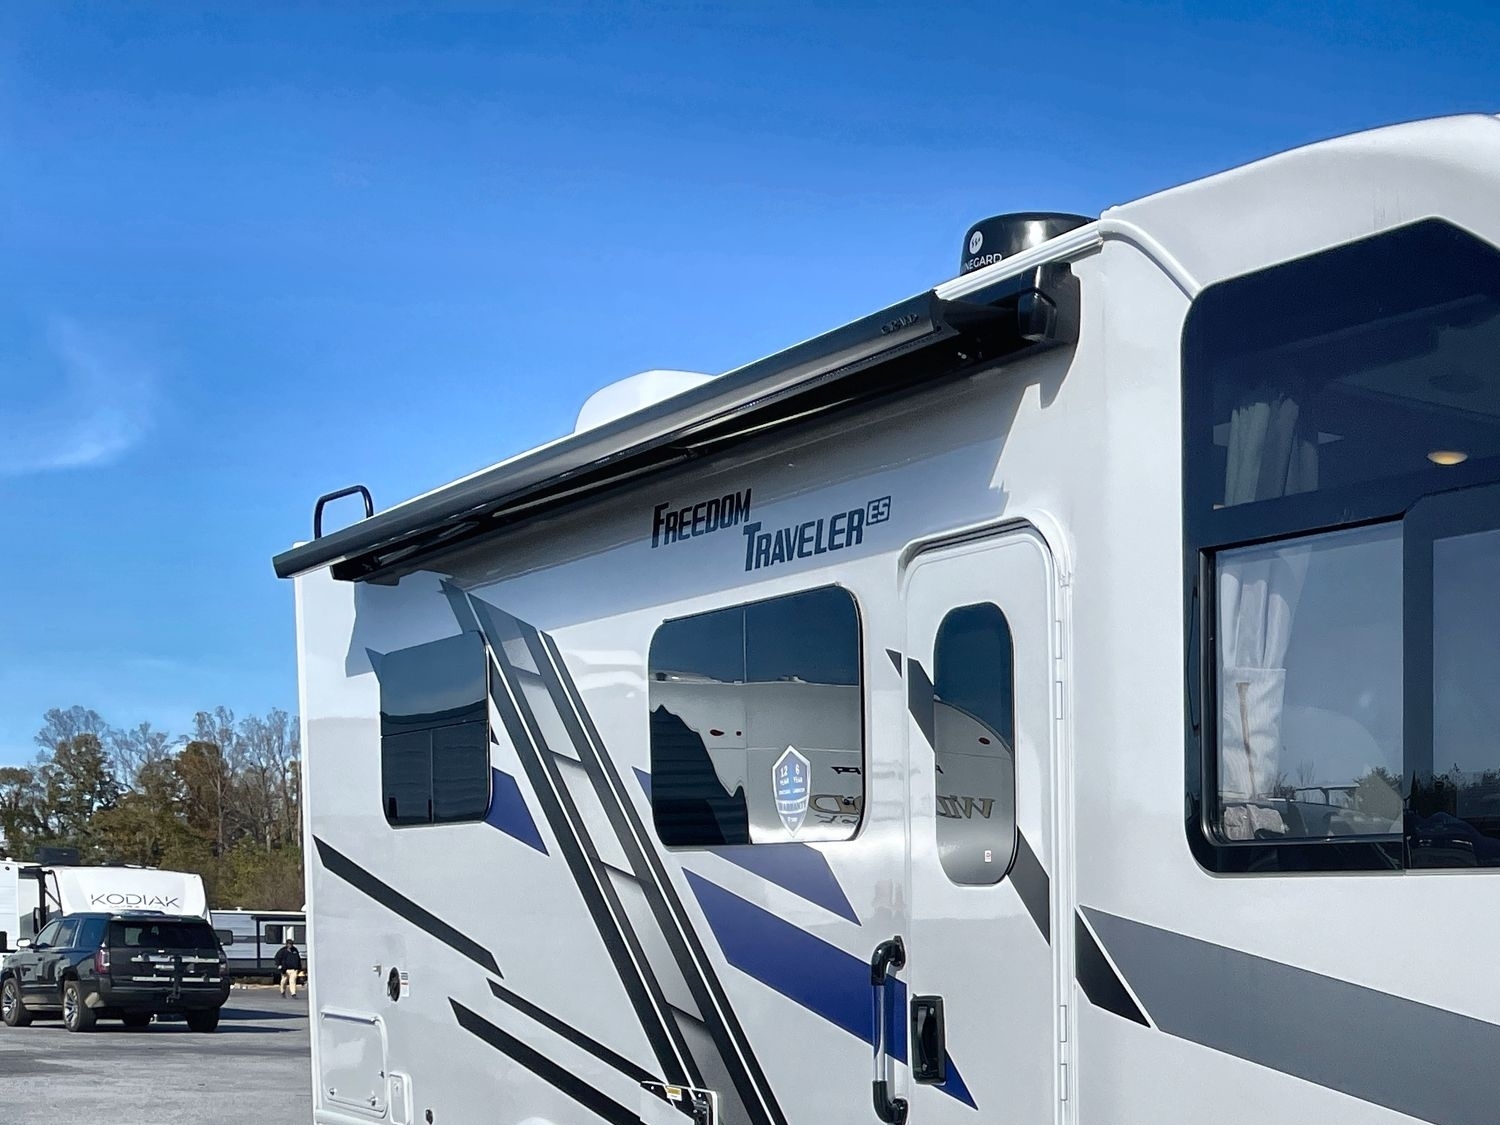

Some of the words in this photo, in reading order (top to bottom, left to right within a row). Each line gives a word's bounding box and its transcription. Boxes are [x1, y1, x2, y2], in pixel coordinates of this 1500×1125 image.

[651, 488, 752, 549] FREEDOM
[743, 507, 865, 572] TRAVELER
[866, 496, 892, 526] ES
[91, 893, 180, 908] KODIAK
